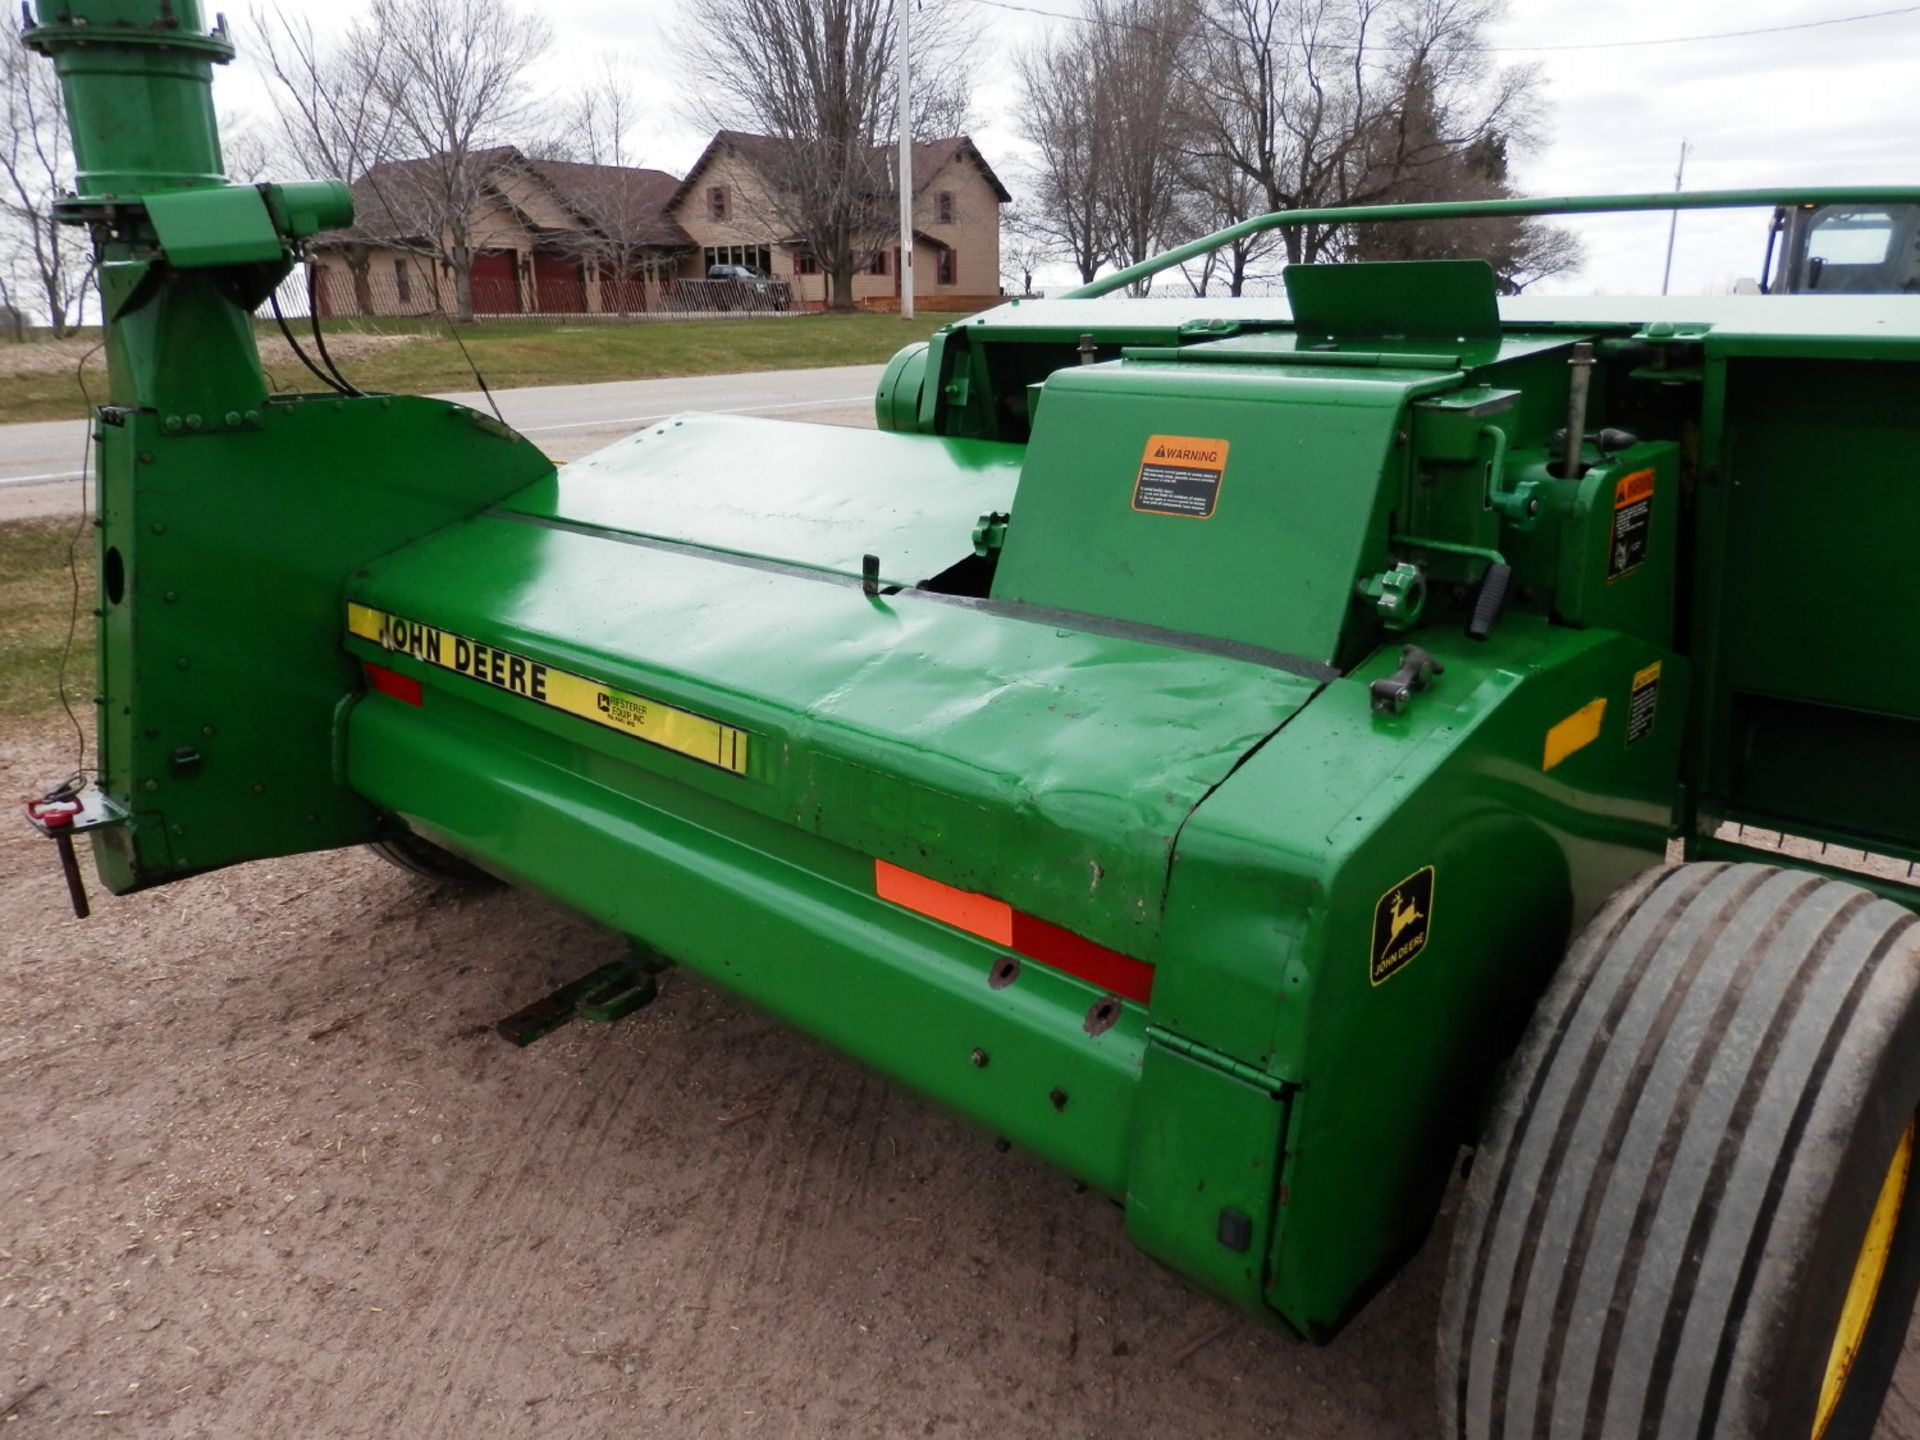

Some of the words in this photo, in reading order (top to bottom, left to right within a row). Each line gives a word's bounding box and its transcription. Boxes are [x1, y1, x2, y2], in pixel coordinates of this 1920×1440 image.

[1167, 448, 1217, 462] WARNING
[379, 614, 441, 663] JOHN
[455, 637, 546, 701] DEERE
[1375, 951, 1397, 976] JOHN
[1398, 931, 1425, 959] DEERE
